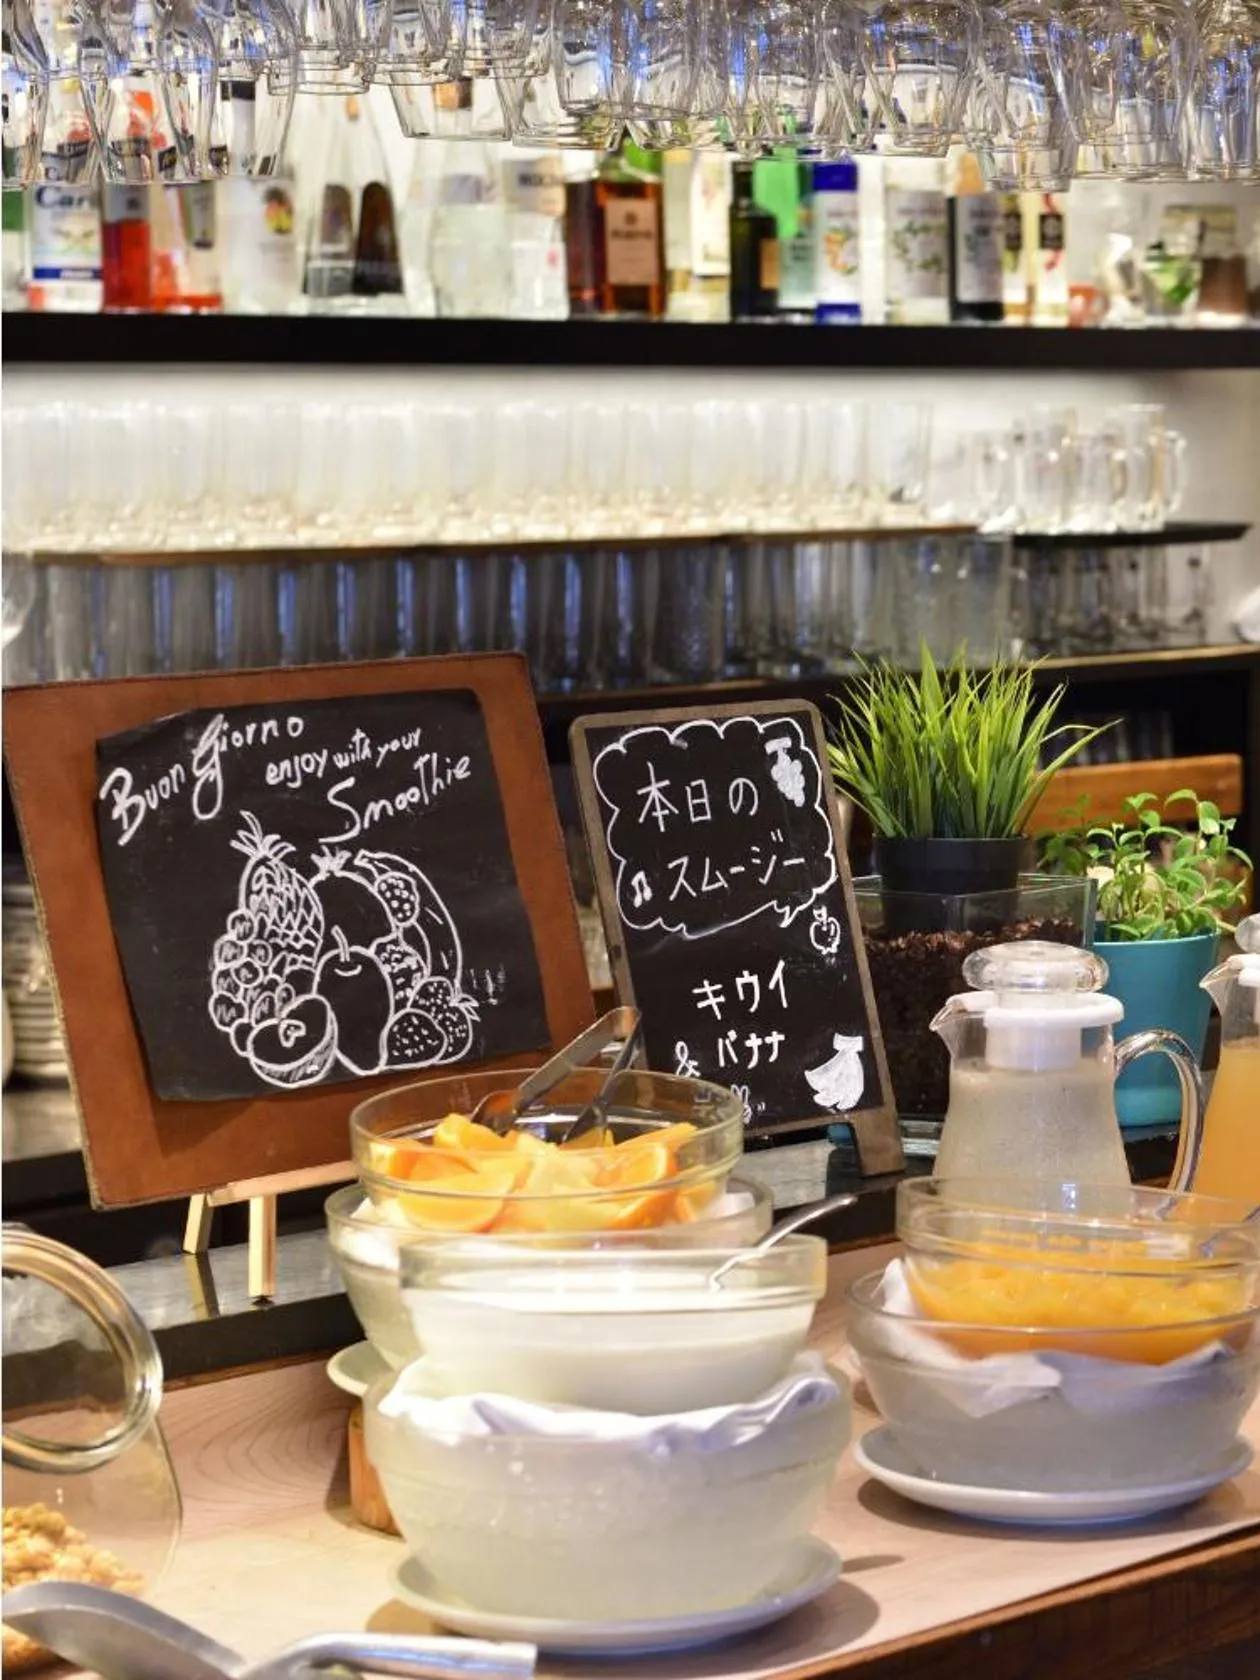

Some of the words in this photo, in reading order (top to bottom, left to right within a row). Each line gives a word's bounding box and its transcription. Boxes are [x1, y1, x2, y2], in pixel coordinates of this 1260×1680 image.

[265, 749, 328, 788] enjoy
[333, 728, 373, 769] with
[375, 728, 422, 768] your
[636, 761, 759, 833] 本日の
[667, 830, 805, 901] スムージー
[692, 959, 788, 1020] キウイ
[717, 1029, 785, 1069] バナナ
